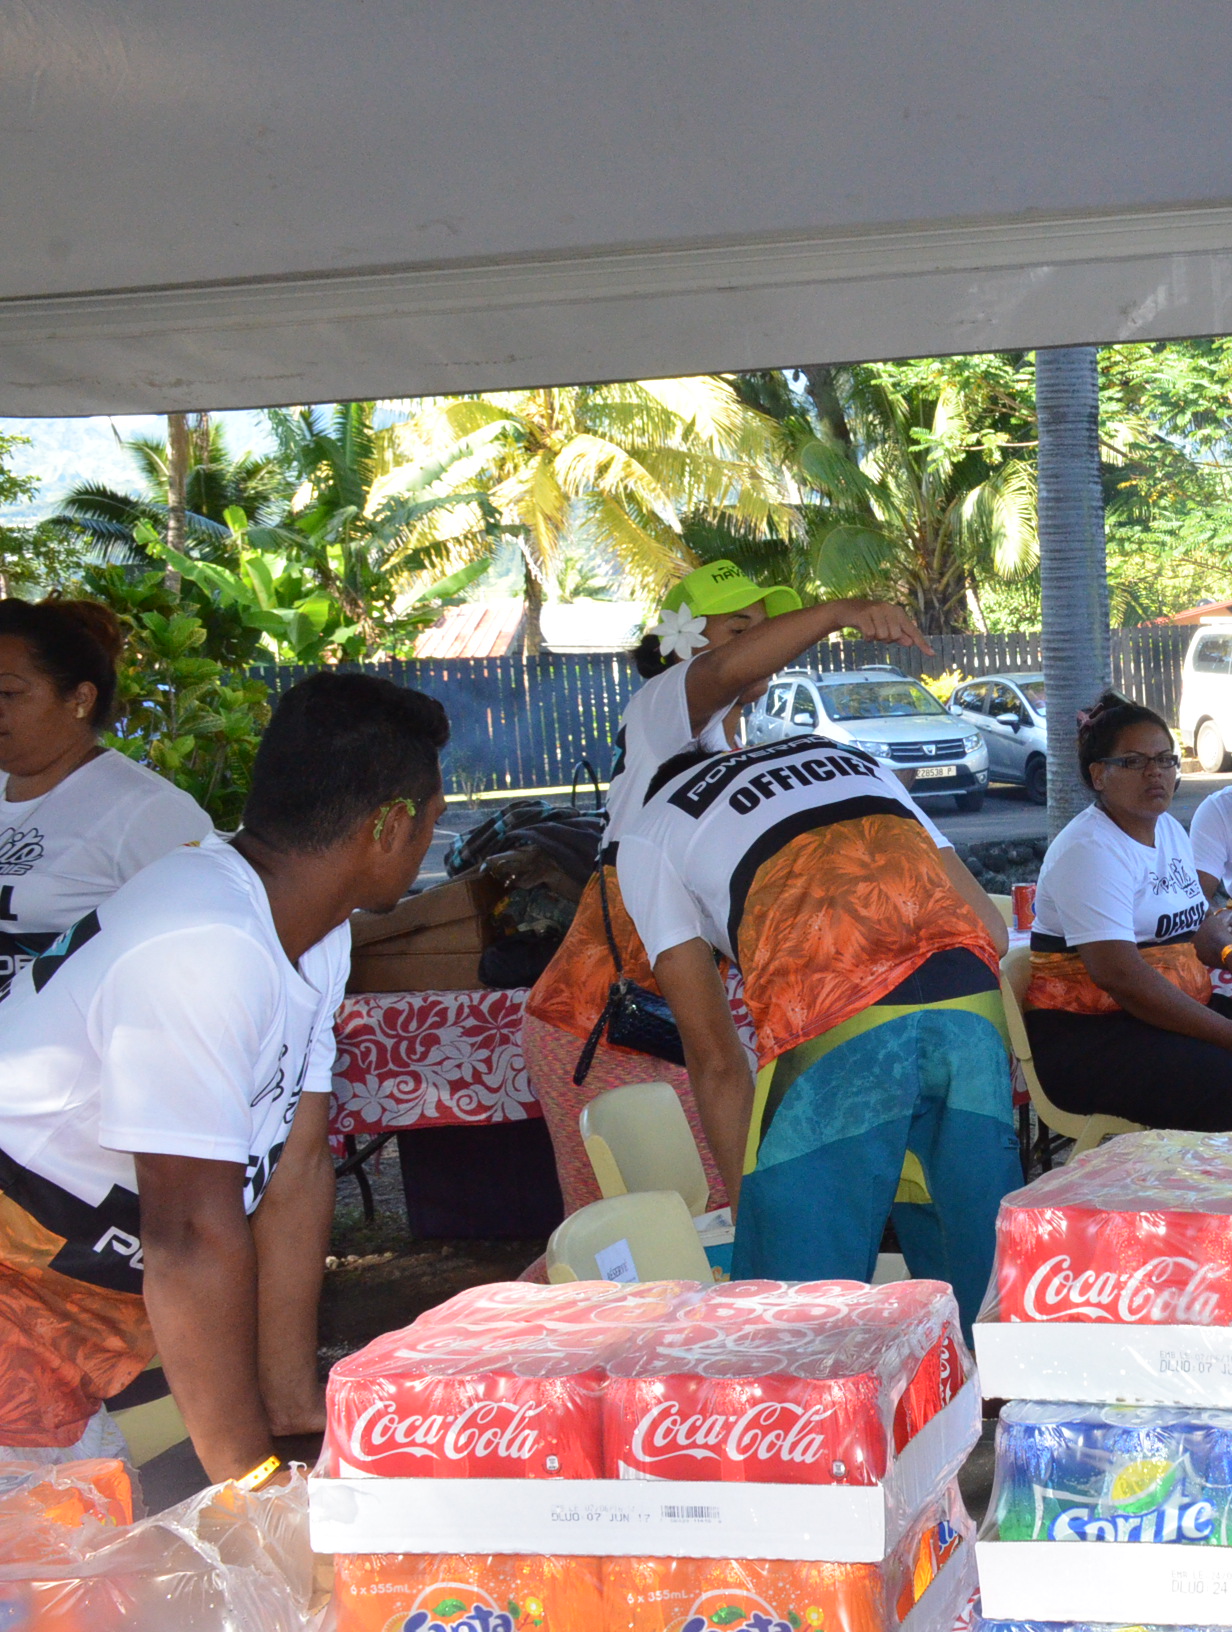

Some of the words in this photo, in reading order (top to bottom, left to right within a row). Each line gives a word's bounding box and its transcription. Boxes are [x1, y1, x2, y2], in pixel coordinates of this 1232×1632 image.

[1023, 1255, 1231, 1325] Coca-Cola
[350, 1399, 548, 1462] Coca-Cola
[632, 1400, 838, 1464] Coca-Cola
[609, 1513, 630, 1522] JUN
[350, 1585, 358, 1595] 6
[626, 1593, 635, 1604] 6
